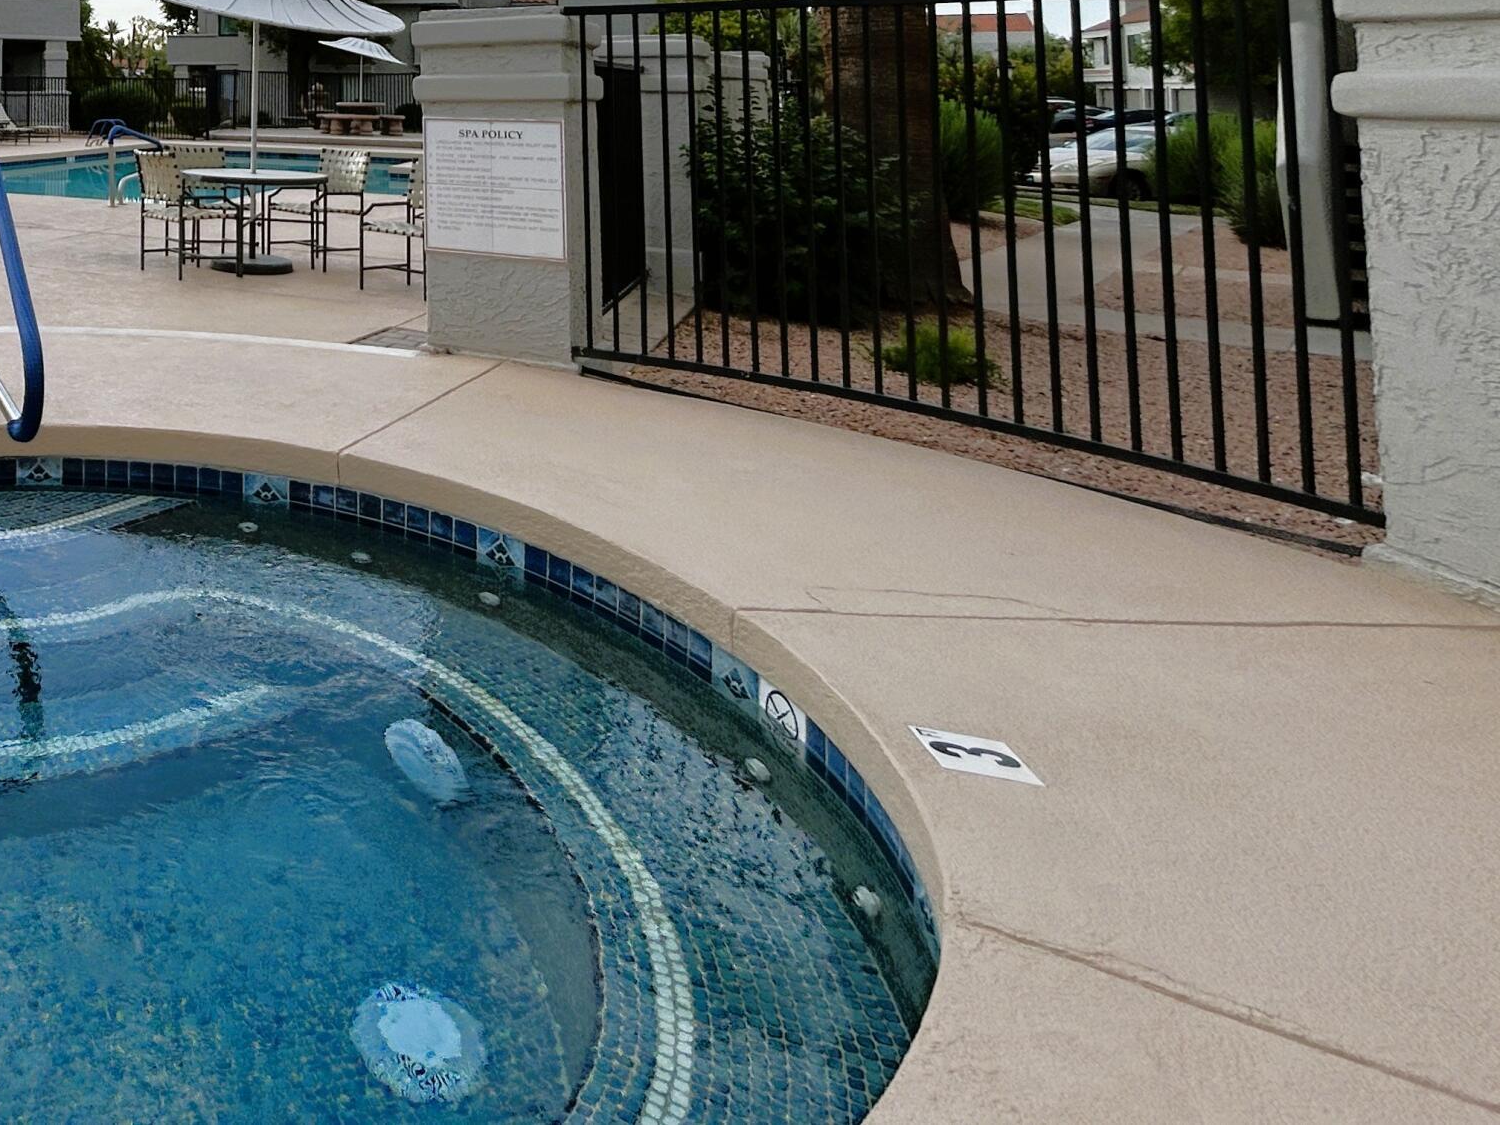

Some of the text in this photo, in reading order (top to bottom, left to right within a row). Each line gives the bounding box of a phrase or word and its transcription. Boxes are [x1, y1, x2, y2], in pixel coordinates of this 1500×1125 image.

[458, 129, 523, 140] SPA POLICY
[928, 741, 1022, 768] 3
